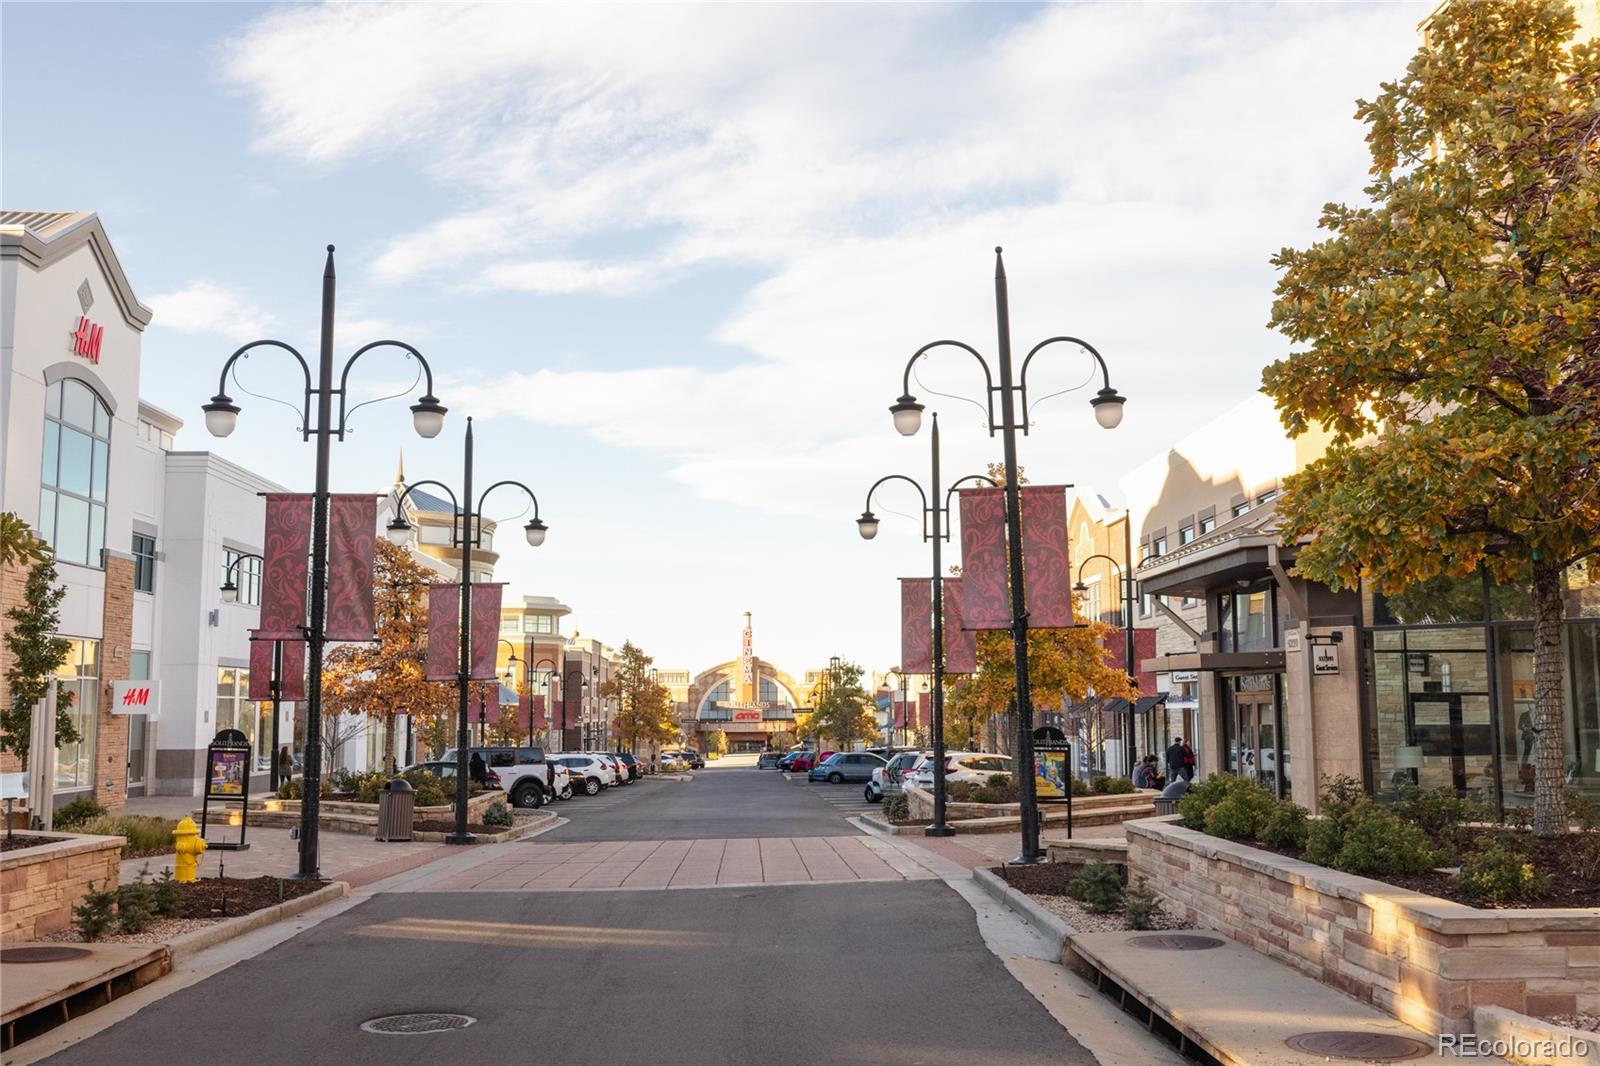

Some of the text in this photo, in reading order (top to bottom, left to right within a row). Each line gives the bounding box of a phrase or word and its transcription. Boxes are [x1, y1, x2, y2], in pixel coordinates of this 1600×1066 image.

[74, 316, 104, 364] H&M
[743, 630, 752, 682] CINEMA
[122, 688, 149, 706] H&M
